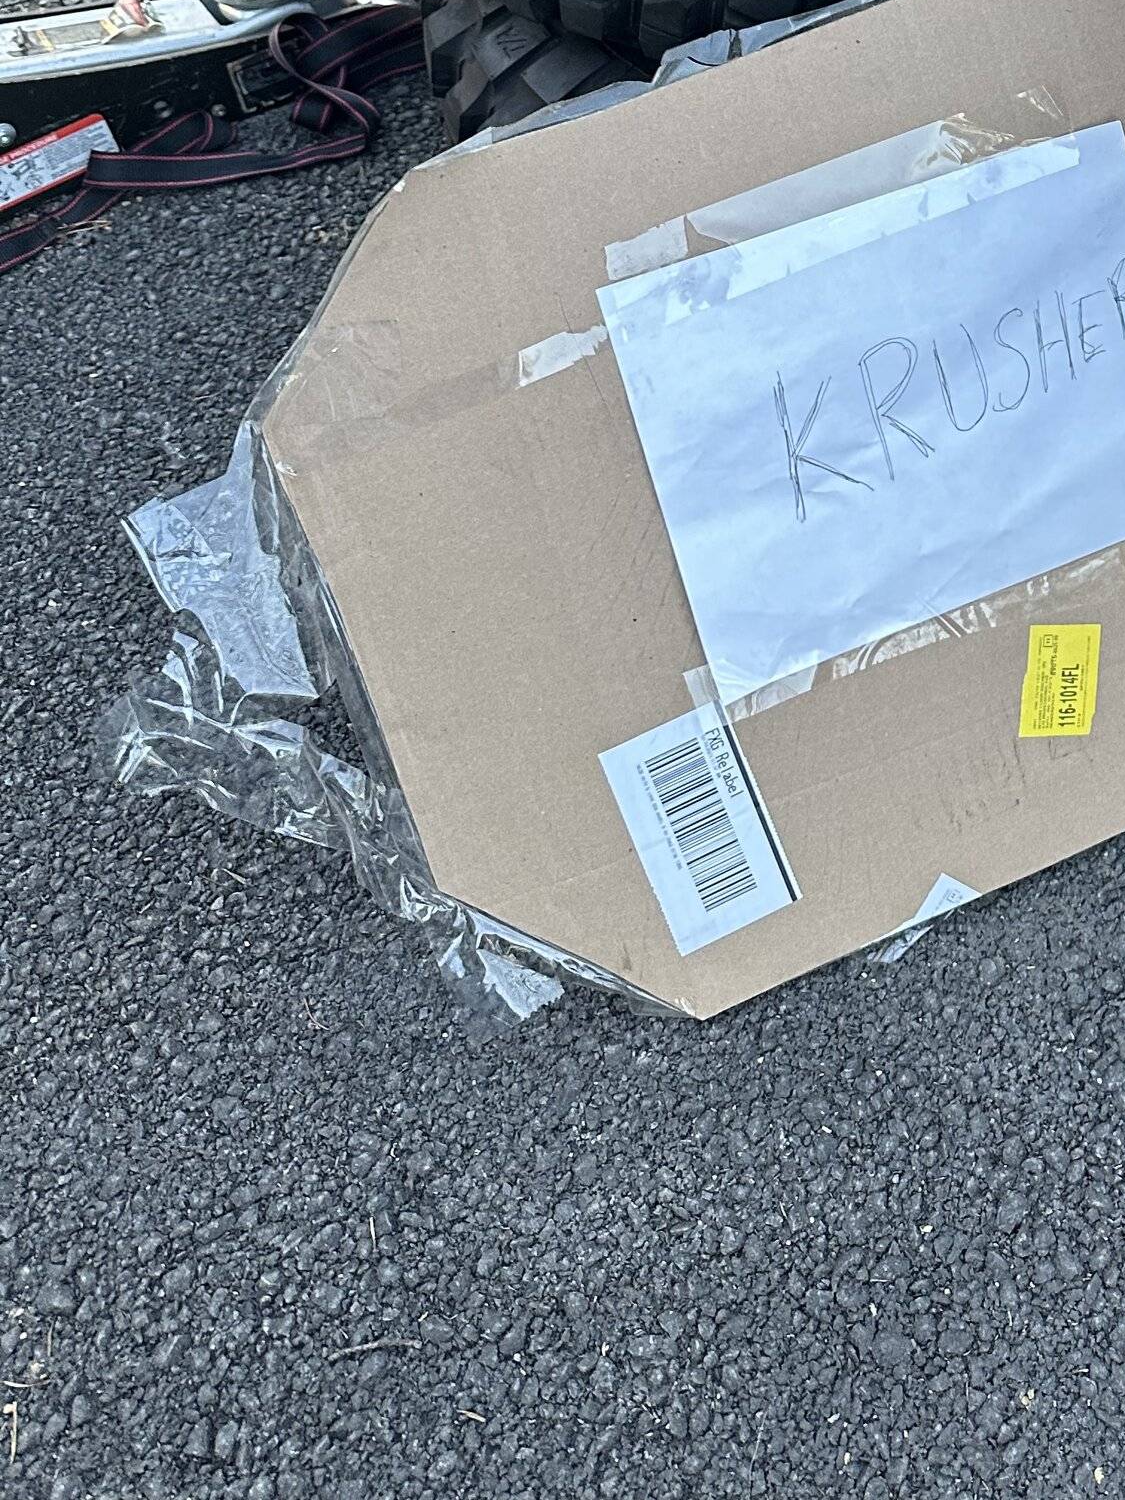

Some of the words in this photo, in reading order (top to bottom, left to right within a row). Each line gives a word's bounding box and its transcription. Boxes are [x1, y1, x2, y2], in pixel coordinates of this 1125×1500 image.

[1058, 662, 1080, 728] 116-1014FL
[704, 726, 725, 752] FXG
[714, 751, 745, 799] Relabel
